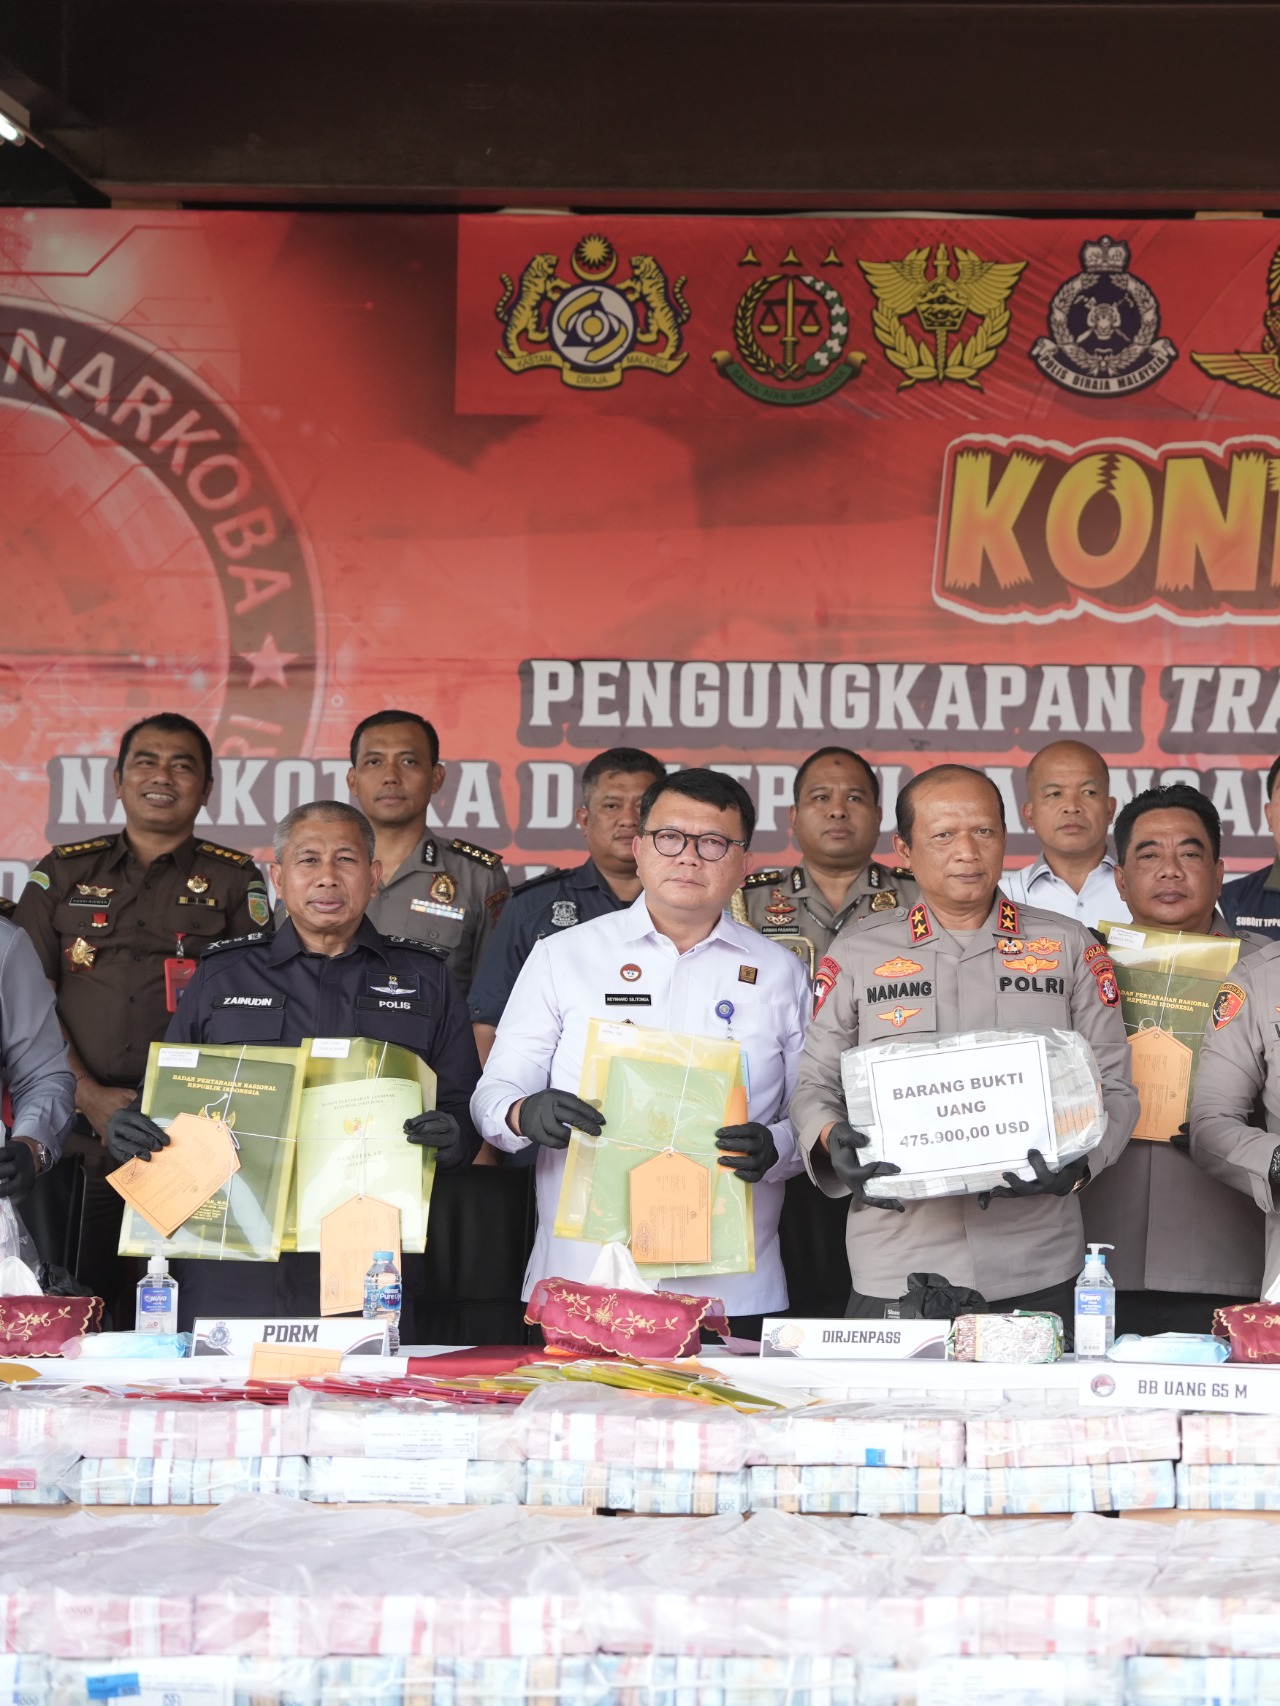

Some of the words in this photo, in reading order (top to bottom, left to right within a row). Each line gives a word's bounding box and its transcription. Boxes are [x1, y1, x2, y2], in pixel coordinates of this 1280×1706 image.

[517, 355, 553, 368] KASTAM
[626, 355, 668, 371] MALAYSIA
[576, 375, 607, 384] DIRAJA
[1040, 354, 1067, 380] POLIS
[1072, 375, 1111, 390] DIRAJA
[1117, 356, 1166, 388] MALAYSIA
[4, 328, 292, 614] NARKOBA
[530, 660, 1132, 733] PENGUNGKAPAN
[1236, 916, 1262, 927] SUBDIT
[867, 981, 933, 1003] NANANG
[999, 976, 1065, 994] POLRI
[223, 996, 273, 1006] ZAINUDIN
[378, 1000, 411, 1010] POLIS
[1126, 997, 1158, 1006] REPUBLIK
[1159, 1001, 1194, 1011] INDONESIA
[1178, 997, 1210, 1008] NASIONAL
[172, 1075, 197, 1084] BADAN
[243, 1083, 277, 1092] NASIONAL
[188, 1082, 222, 1091] REPUBLIK
[222, 1086, 260, 1096] INDONESIA
[892, 1078, 965, 1101] BARANG
[970, 1071, 1024, 1089] BUKTI
[936, 1100, 987, 1119] UANG
[995, 1119, 1030, 1136] USD
[262, 1324, 319, 1343] PDRM
[822, 1329, 902, 1345] DIRJENPASS
[1138, 1379, 1159, 1396] BB
[1164, 1381, 1207, 1397] UANG
[1211, 1383, 1230, 1399] 65
[1235, 1384, 1248, 1399] M
